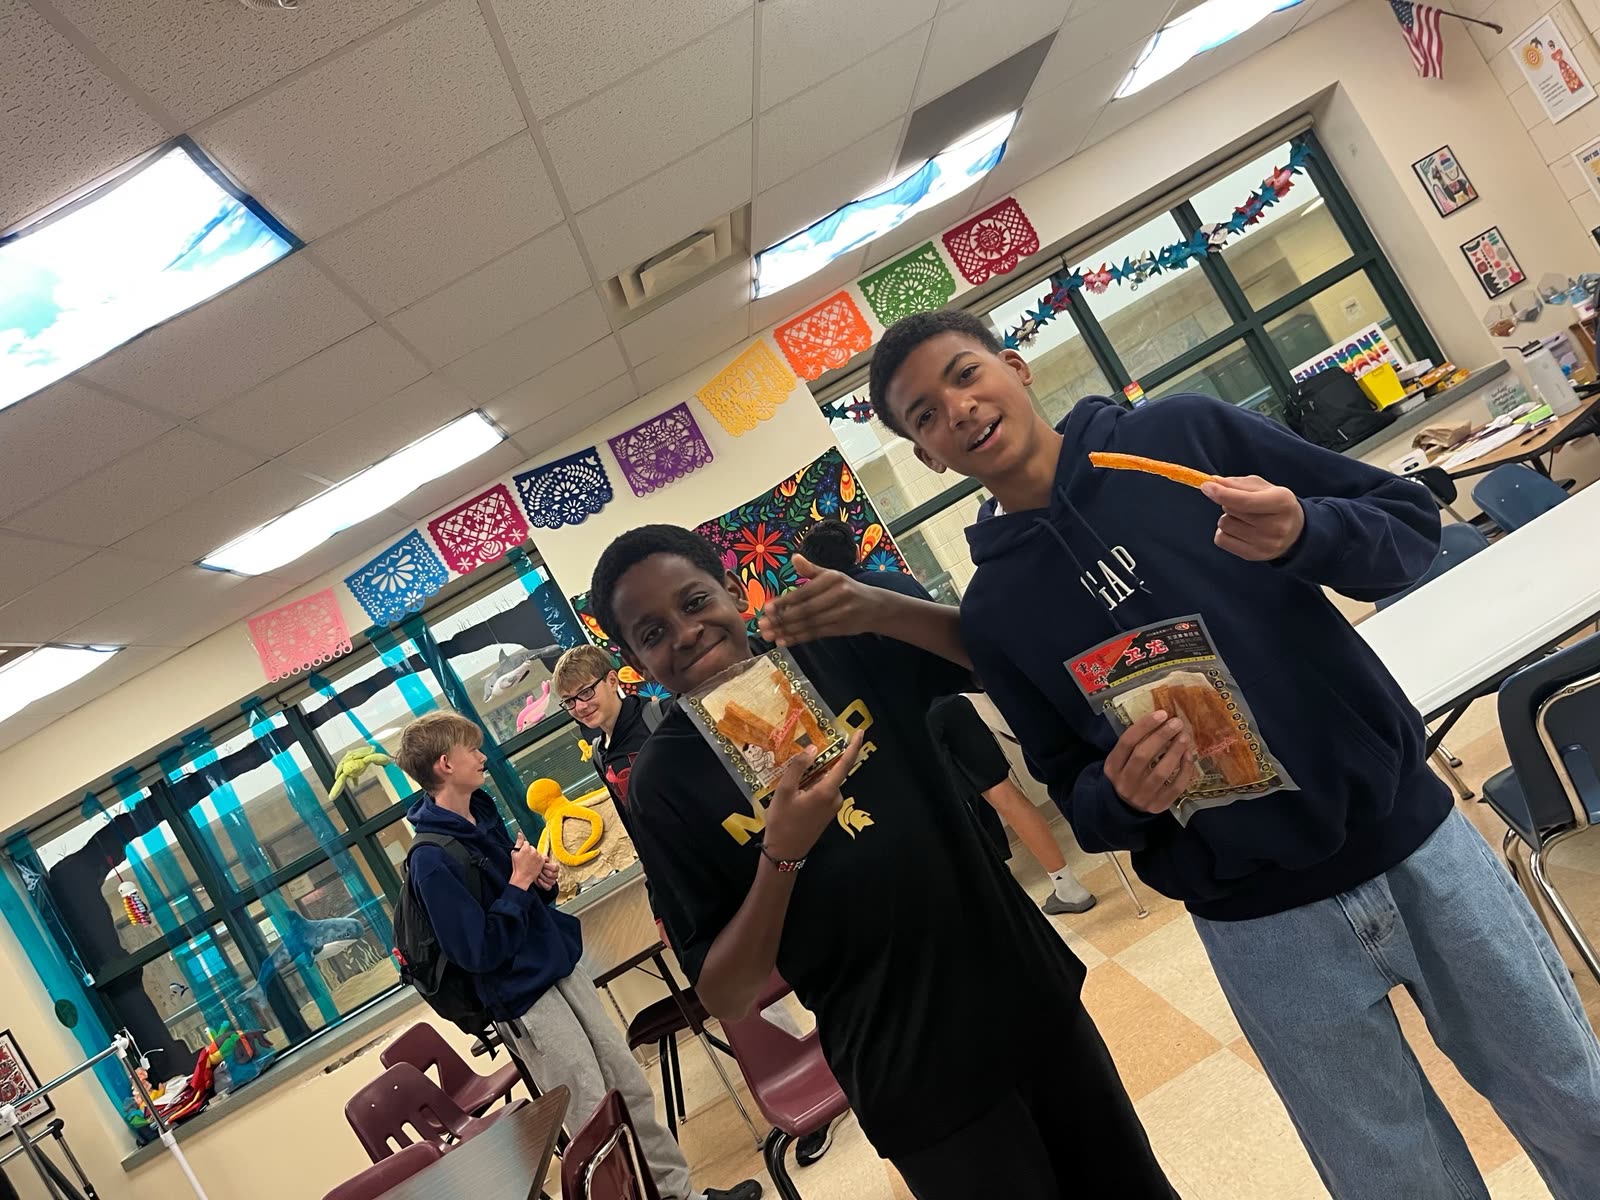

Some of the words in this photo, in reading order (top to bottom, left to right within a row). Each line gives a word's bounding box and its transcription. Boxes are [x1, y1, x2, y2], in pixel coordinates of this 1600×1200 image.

[1294, 329, 1383, 384] EVERYONE
[1079, 545, 1145, 612] GAP
[1124, 639, 1170, 667] 卫龙
